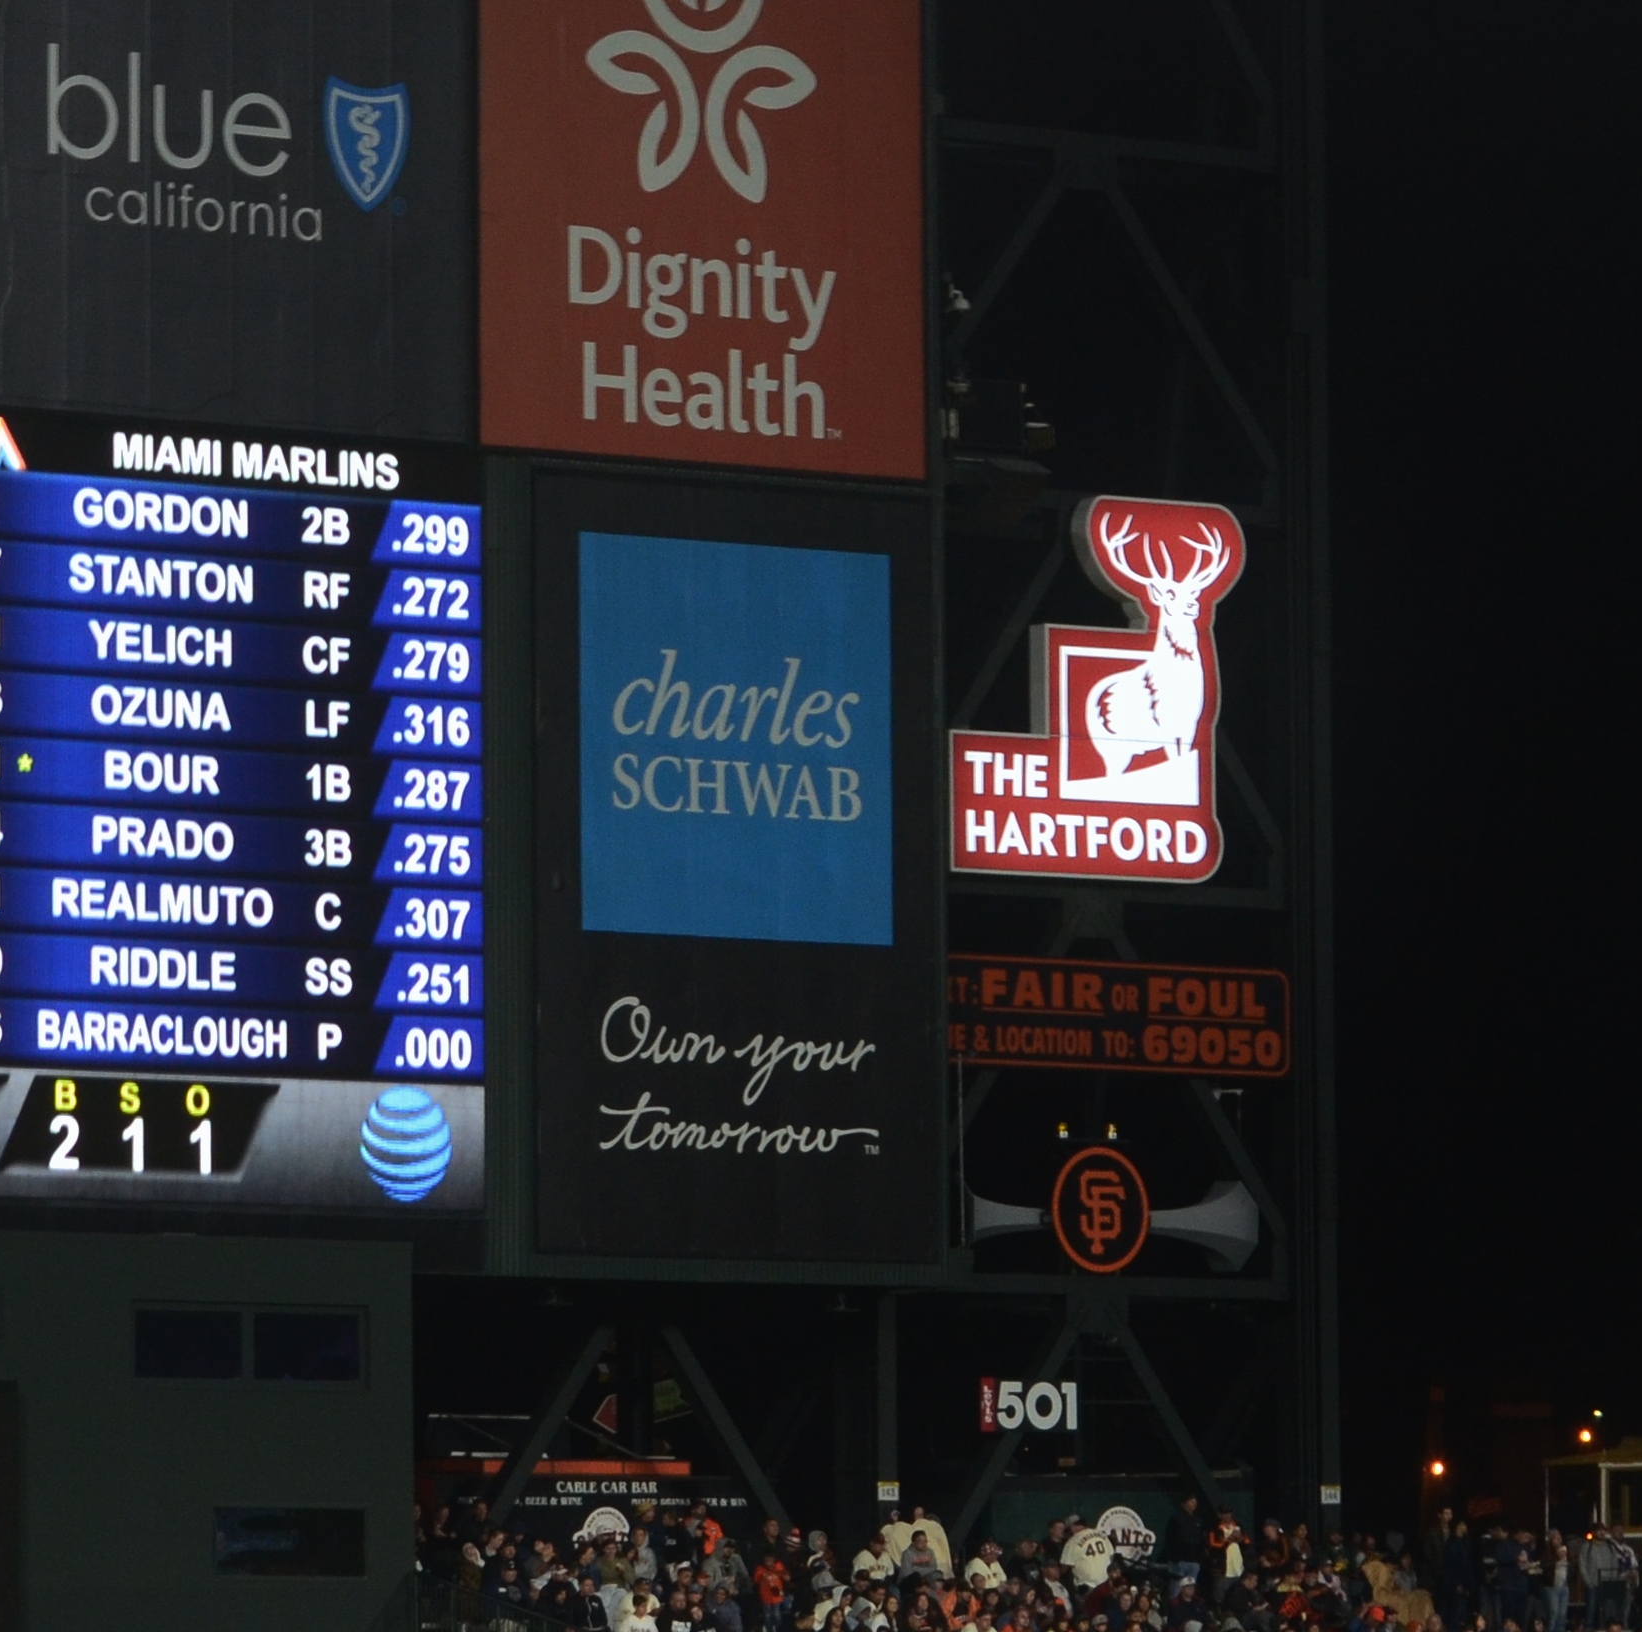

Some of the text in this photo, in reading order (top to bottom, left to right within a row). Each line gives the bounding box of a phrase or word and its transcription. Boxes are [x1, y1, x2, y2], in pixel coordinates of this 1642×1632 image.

[46, 43, 292, 177] blue
[84, 182, 323, 243] california
[567, 224, 836, 352] Dignity
[582, 340, 827, 442] Health
[112, 432, 400, 490] MIAMI MARLINS
[73, 487, 248, 539] GORDON
[301, 507, 350, 545] 2B
[392, 513, 470, 557] .299
[68, 553, 254, 605] STANTON
[303, 571, 350, 610] RF
[392, 577, 470, 621] .272
[88, 620, 232, 668] YELICH
[302, 636, 351, 675] CF
[393, 641, 470, 683] .279
[90, 684, 231, 733] OZUNA
[305, 700, 350, 739] LF
[393, 704, 471, 748] .316
[612, 648, 859, 749] charles
[104, 749, 220, 796] BOUR
[305, 764, 352, 803] 1B
[393, 769, 470, 811] .287
[612, 752, 862, 823] SCHWAB
[964, 750, 1049, 799] THE
[92, 815, 234, 861] PRADO
[304, 829, 353, 868] 3B
[394, 833, 471, 875] .275
[964, 809, 1208, 865] HARTFORD
[52, 877, 274, 927] REALMUTO
[315, 892, 343, 932] C
[394, 898, 471, 940] .307
[90, 946, 237, 991] RIDDLE
[305, 958, 353, 997] SS
[397, 963, 470, 1005] .251
[981, 968, 1266, 1019] FAIR OR FOUL
[37, 1009, 288, 1058] BARRACLOUGH
[317, 1022, 343, 1061] P
[394, 1028, 472, 1070] .000
[599, 996, 875, 1105] Own your
[973, 1024, 1282, 1067] & LOCATION TO: 69050
[599, 1091, 879, 1155] tomorrow
[997, 1381, 1077, 1430] 501
[556, 1480, 658, 1494] CABLE CAR BAR
[1086, 1541, 1105, 1556] 40
